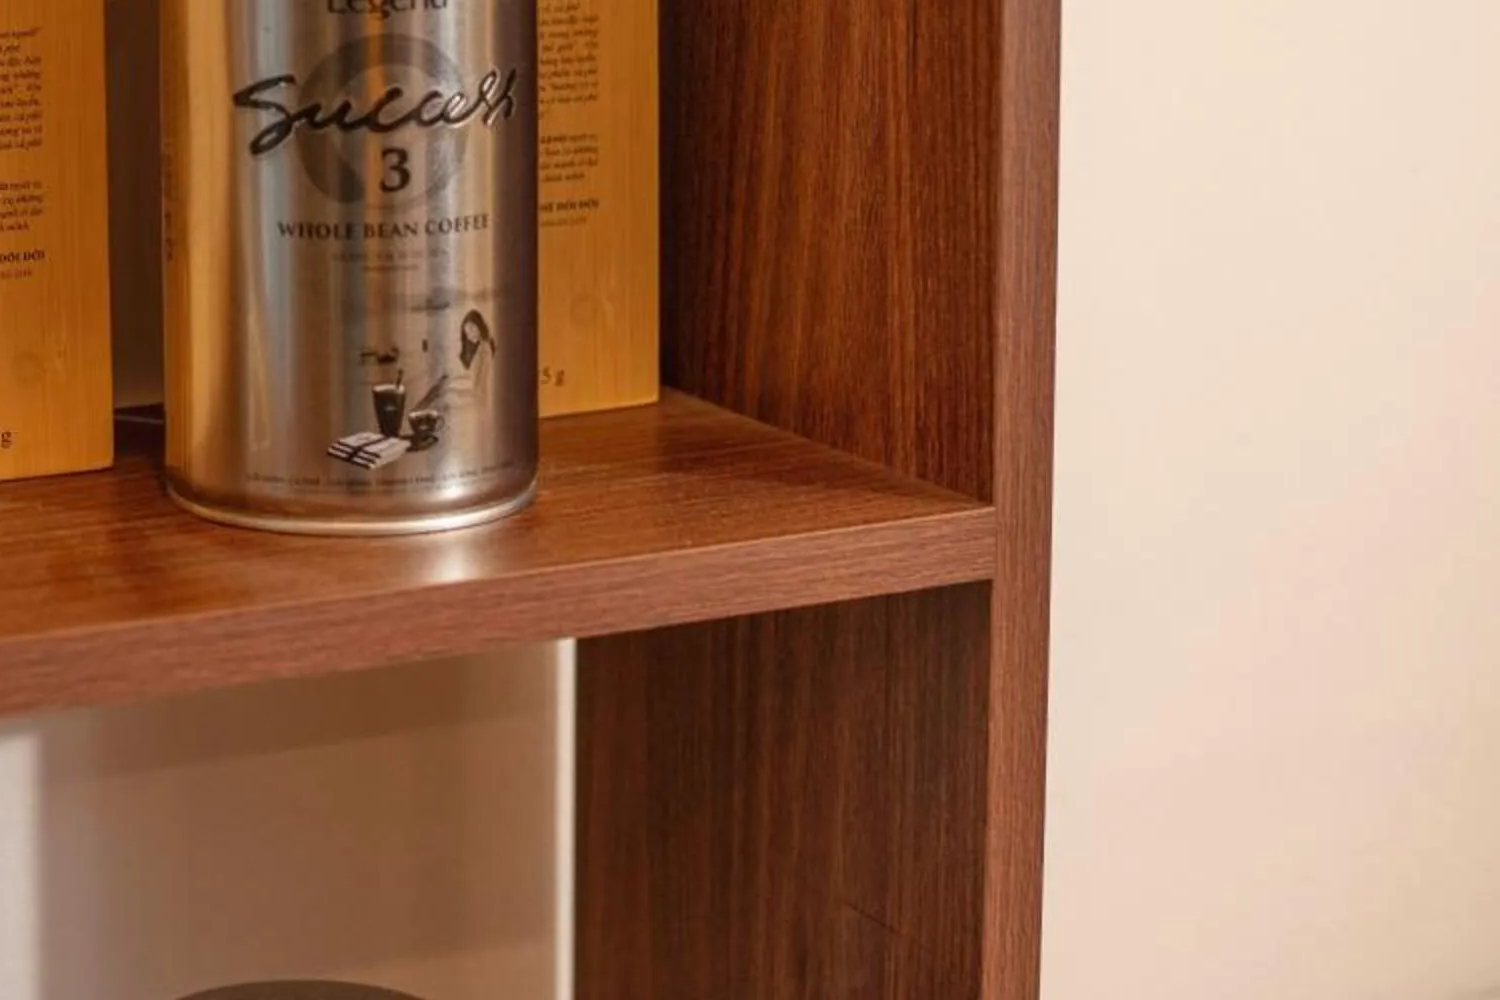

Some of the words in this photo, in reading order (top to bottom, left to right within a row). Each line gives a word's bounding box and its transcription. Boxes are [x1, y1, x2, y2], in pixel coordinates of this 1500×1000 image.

[232, 66, 518, 156] Success
[378, 147, 412, 193] 3
[276, 219, 359, 241] WHOLE
[362, 220, 419, 239] BEAN
[424, 212, 490, 235] COFFEE
[1, 431, 13, 450] g
